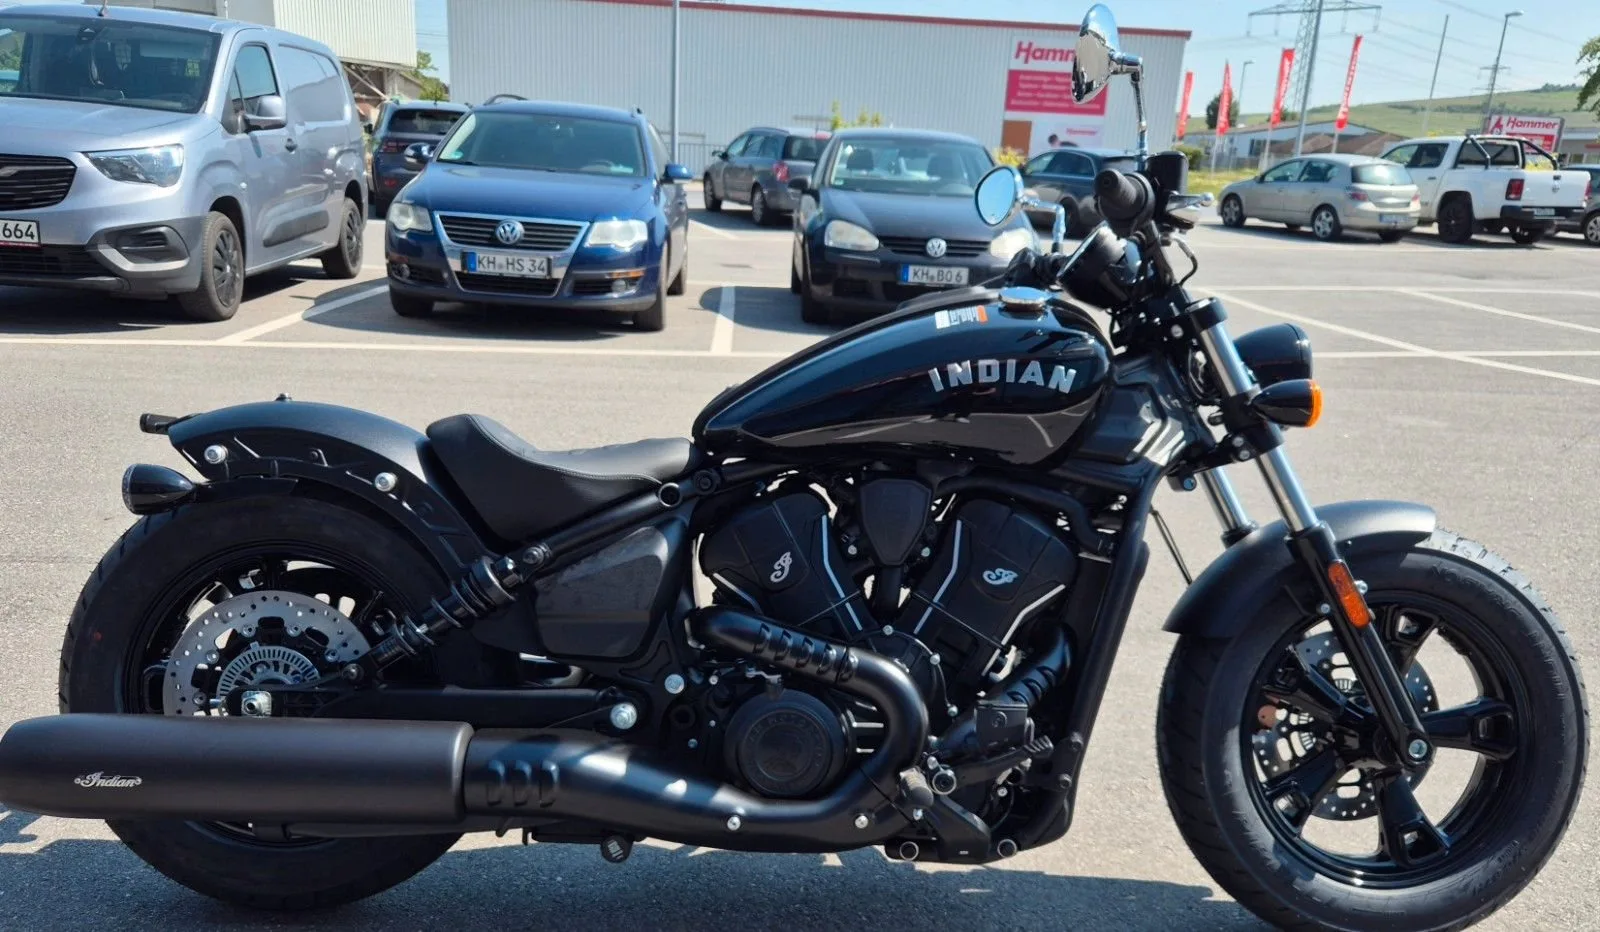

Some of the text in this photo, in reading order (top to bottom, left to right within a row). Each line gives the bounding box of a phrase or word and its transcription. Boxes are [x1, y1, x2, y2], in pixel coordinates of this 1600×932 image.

[1015, 41, 1077, 64] Hamm
[1506, 116, 1558, 129] Hammer
[2, 222, 35, 240] 664
[477, 255, 545, 273] KH HS 34
[913, 267, 929, 281] KH
[955, 271, 963, 283] 6
[928, 358, 1077, 394] INDIAN
[79, 771, 138, 787] Indian
